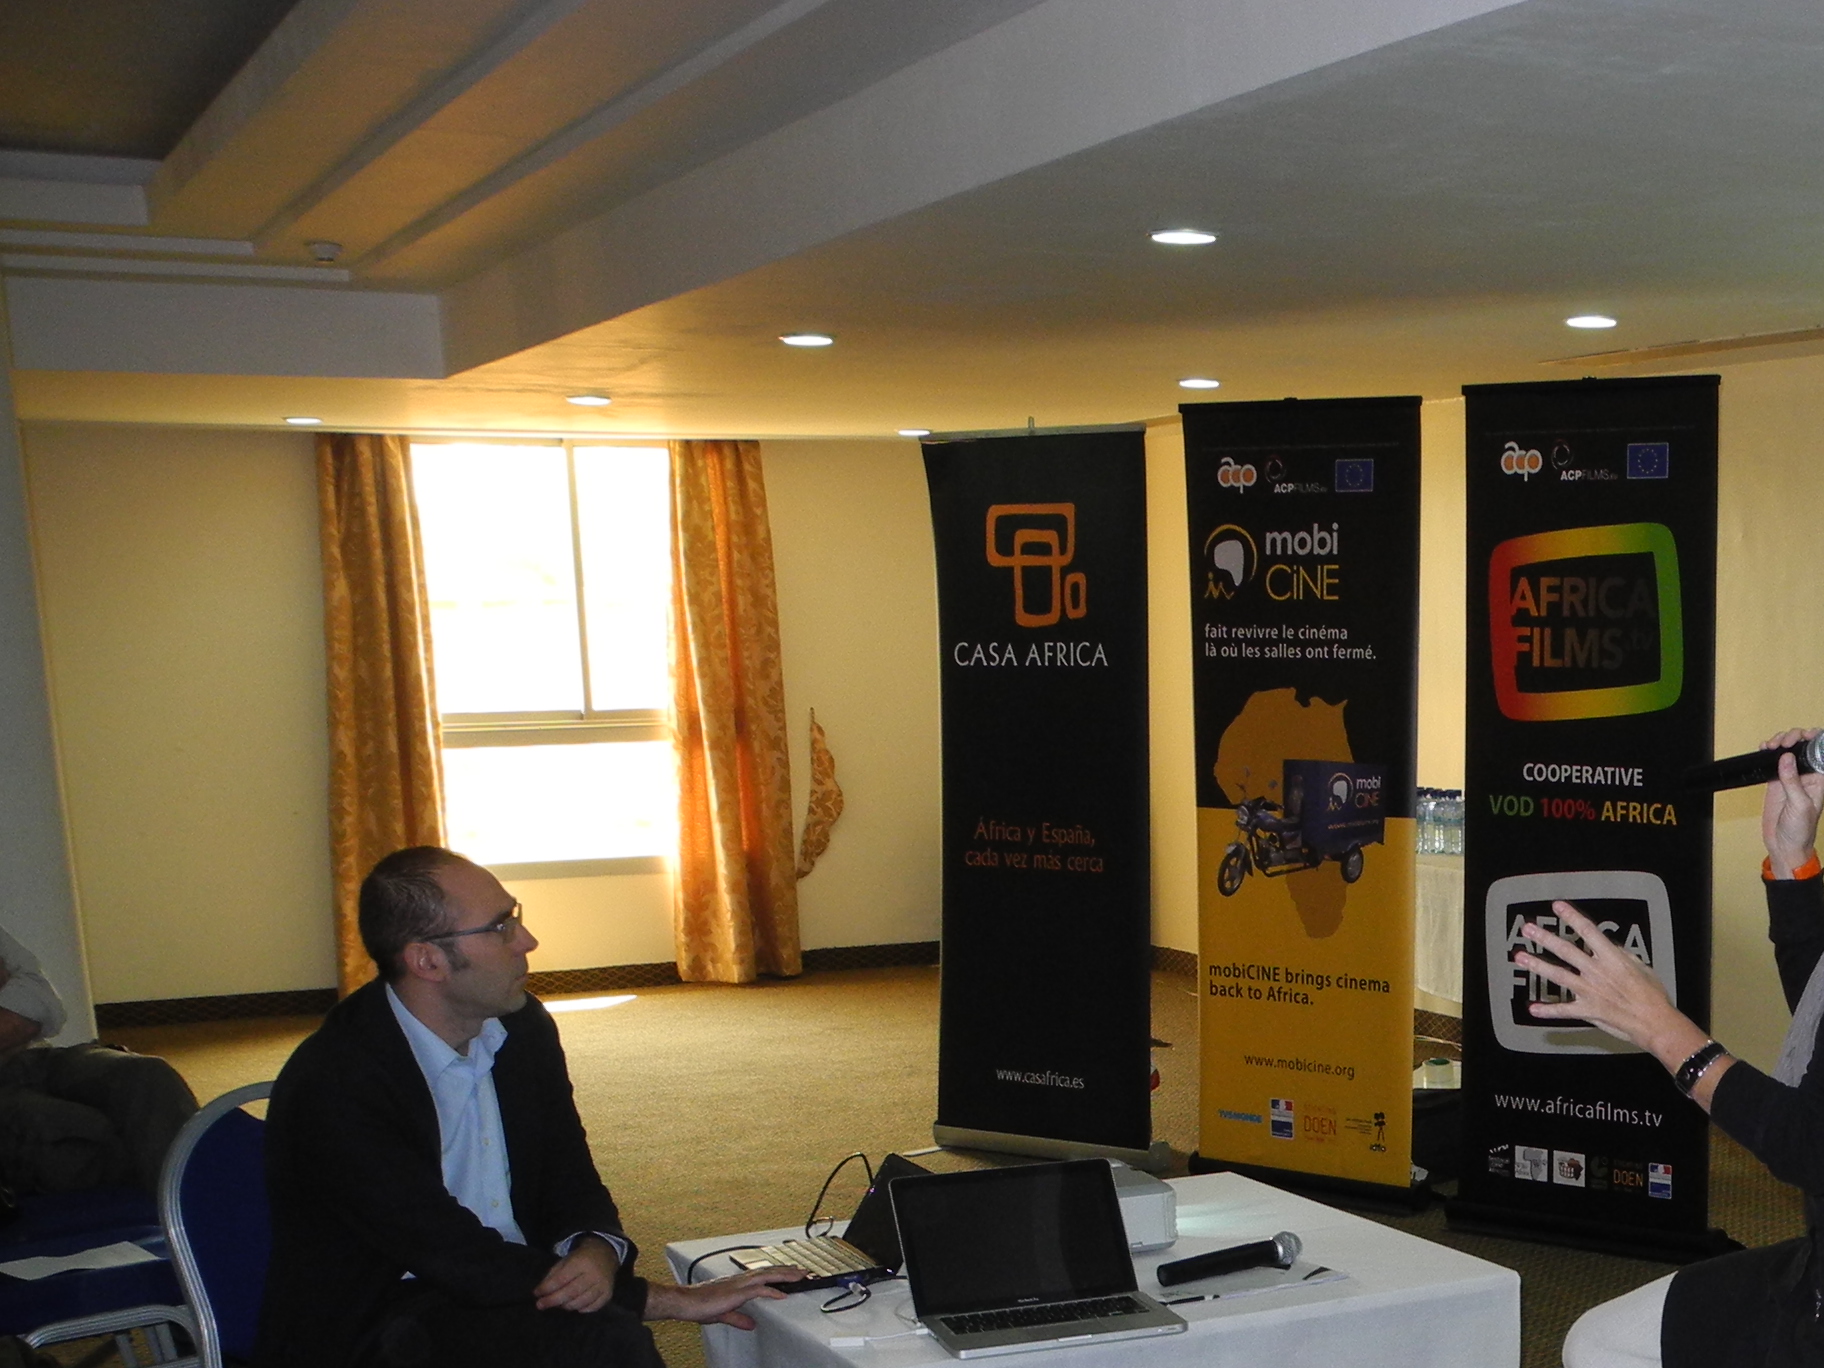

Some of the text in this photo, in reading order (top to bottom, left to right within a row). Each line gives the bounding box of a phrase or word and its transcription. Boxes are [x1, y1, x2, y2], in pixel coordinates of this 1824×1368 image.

[1264, 521, 1340, 556] mobi
[1511, 575, 1657, 620] AFRICA
[1204, 623, 1349, 641] fait revivre le cinéma
[954, 641, 1109, 667] CASA AFRICA
[1205, 642, 1378, 660] là où les salles ont fermé.
[1522, 762, 1644, 787] COOPERATIVE
[1489, 794, 1678, 826] VOD 100% AFRICA
[973, 816, 1096, 848] África y España,
[965, 847, 1105, 873] cada vez más cerca
[1208, 962, 1391, 994] mobiCINE brings cinema
[1208, 980, 1315, 1006] back to Africa.
[996, 1069, 1085, 1090] www.casafrica.es
[1243, 1054, 1356, 1081] www.mobicine.org
[1494, 1094, 1663, 1128] www.africafilms.tv
[1303, 1115, 1337, 1136] DOEN
[1612, 1169, 1644, 1187] DOEN
